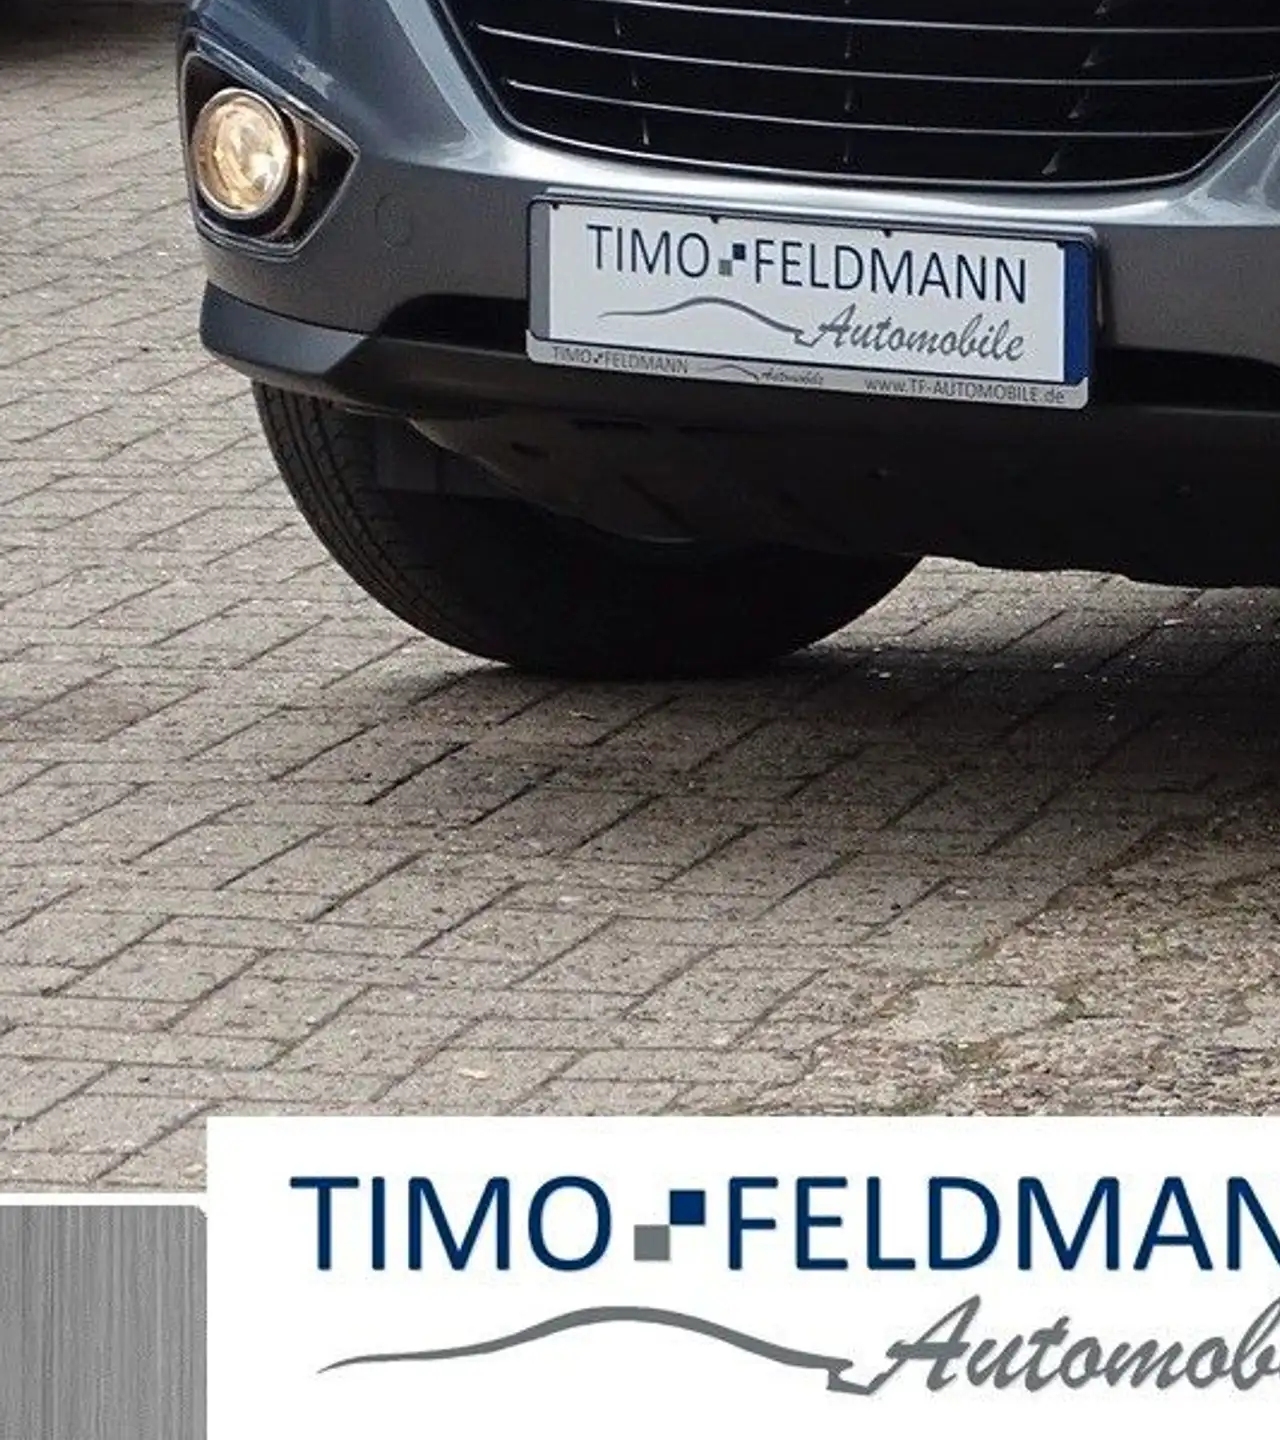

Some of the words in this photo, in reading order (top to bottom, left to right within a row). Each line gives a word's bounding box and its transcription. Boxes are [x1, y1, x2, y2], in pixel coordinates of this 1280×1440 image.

[586, 224, 710, 278] TIMO
[754, 239, 1027, 304] FELDMANN
[815, 303, 1025, 362] Automobile
